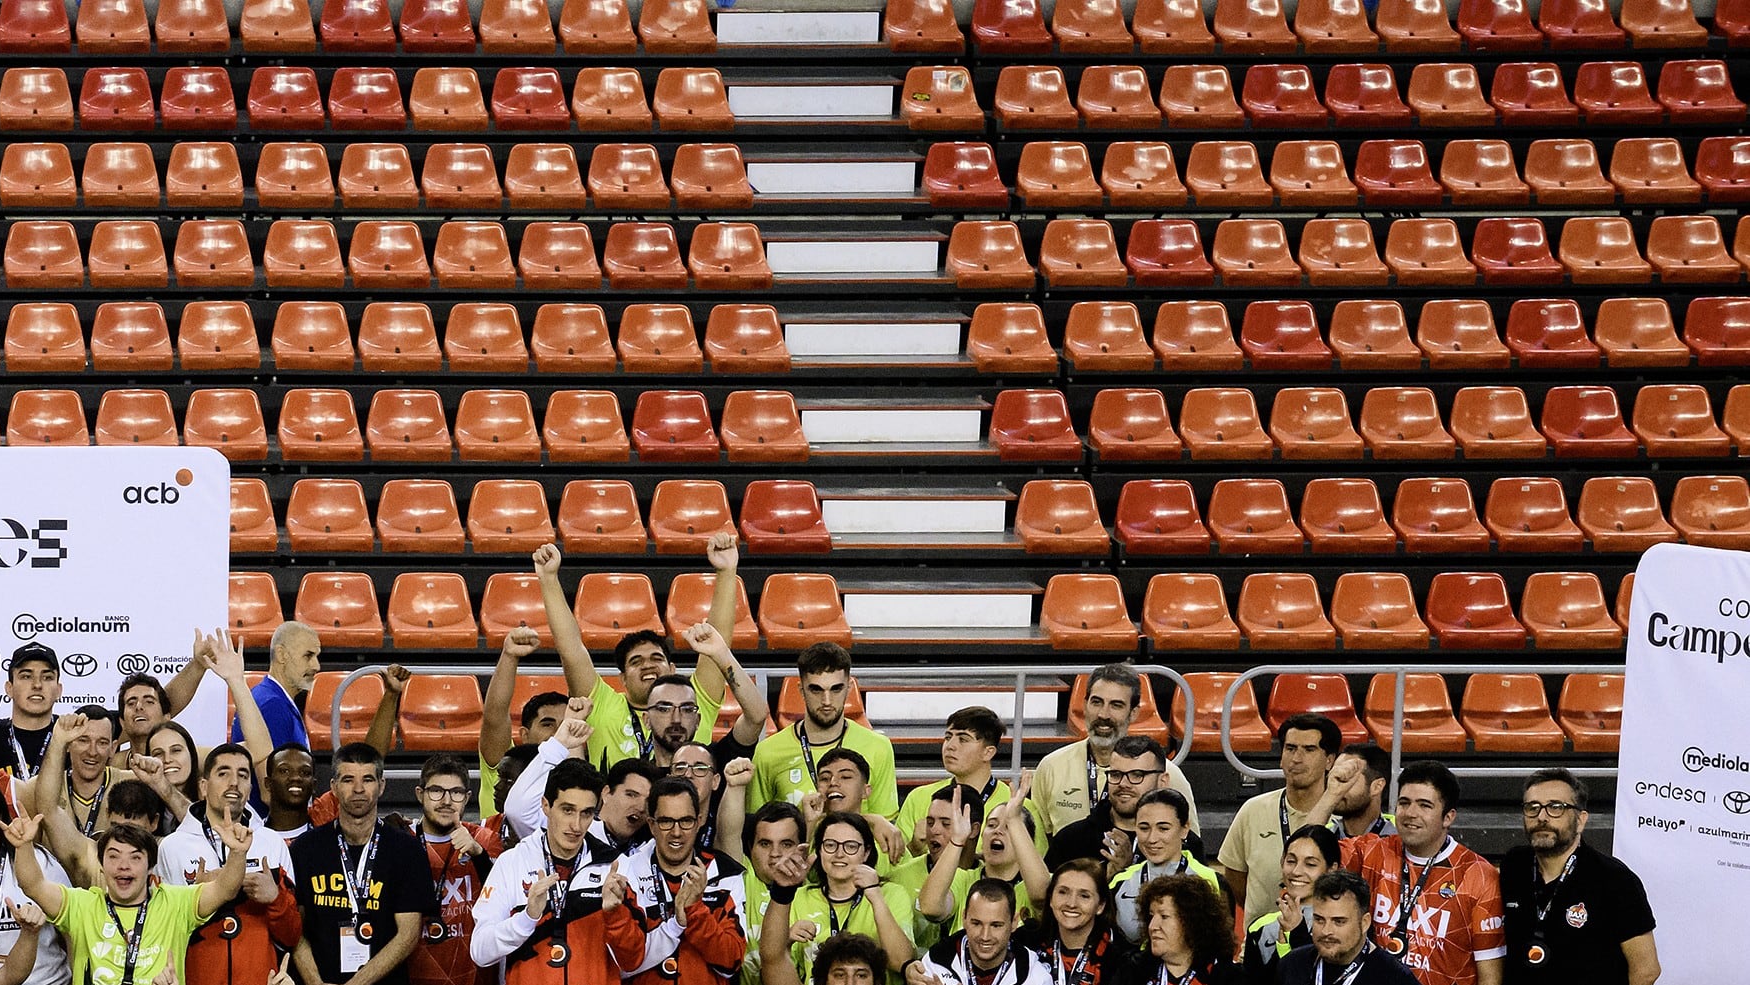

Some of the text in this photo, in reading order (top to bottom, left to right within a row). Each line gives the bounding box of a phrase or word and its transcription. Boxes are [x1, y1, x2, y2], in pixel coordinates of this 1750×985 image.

[122, 482, 180, 504] acb
[15, 615, 131, 634] mediolanum
[153, 664, 184, 674] ONC
[1635, 780, 1706, 804] endesa
[1055, 799, 1083, 810] málaga
[1638, 815, 1678, 832] pelayo
[310, 873, 383, 900] UCM
